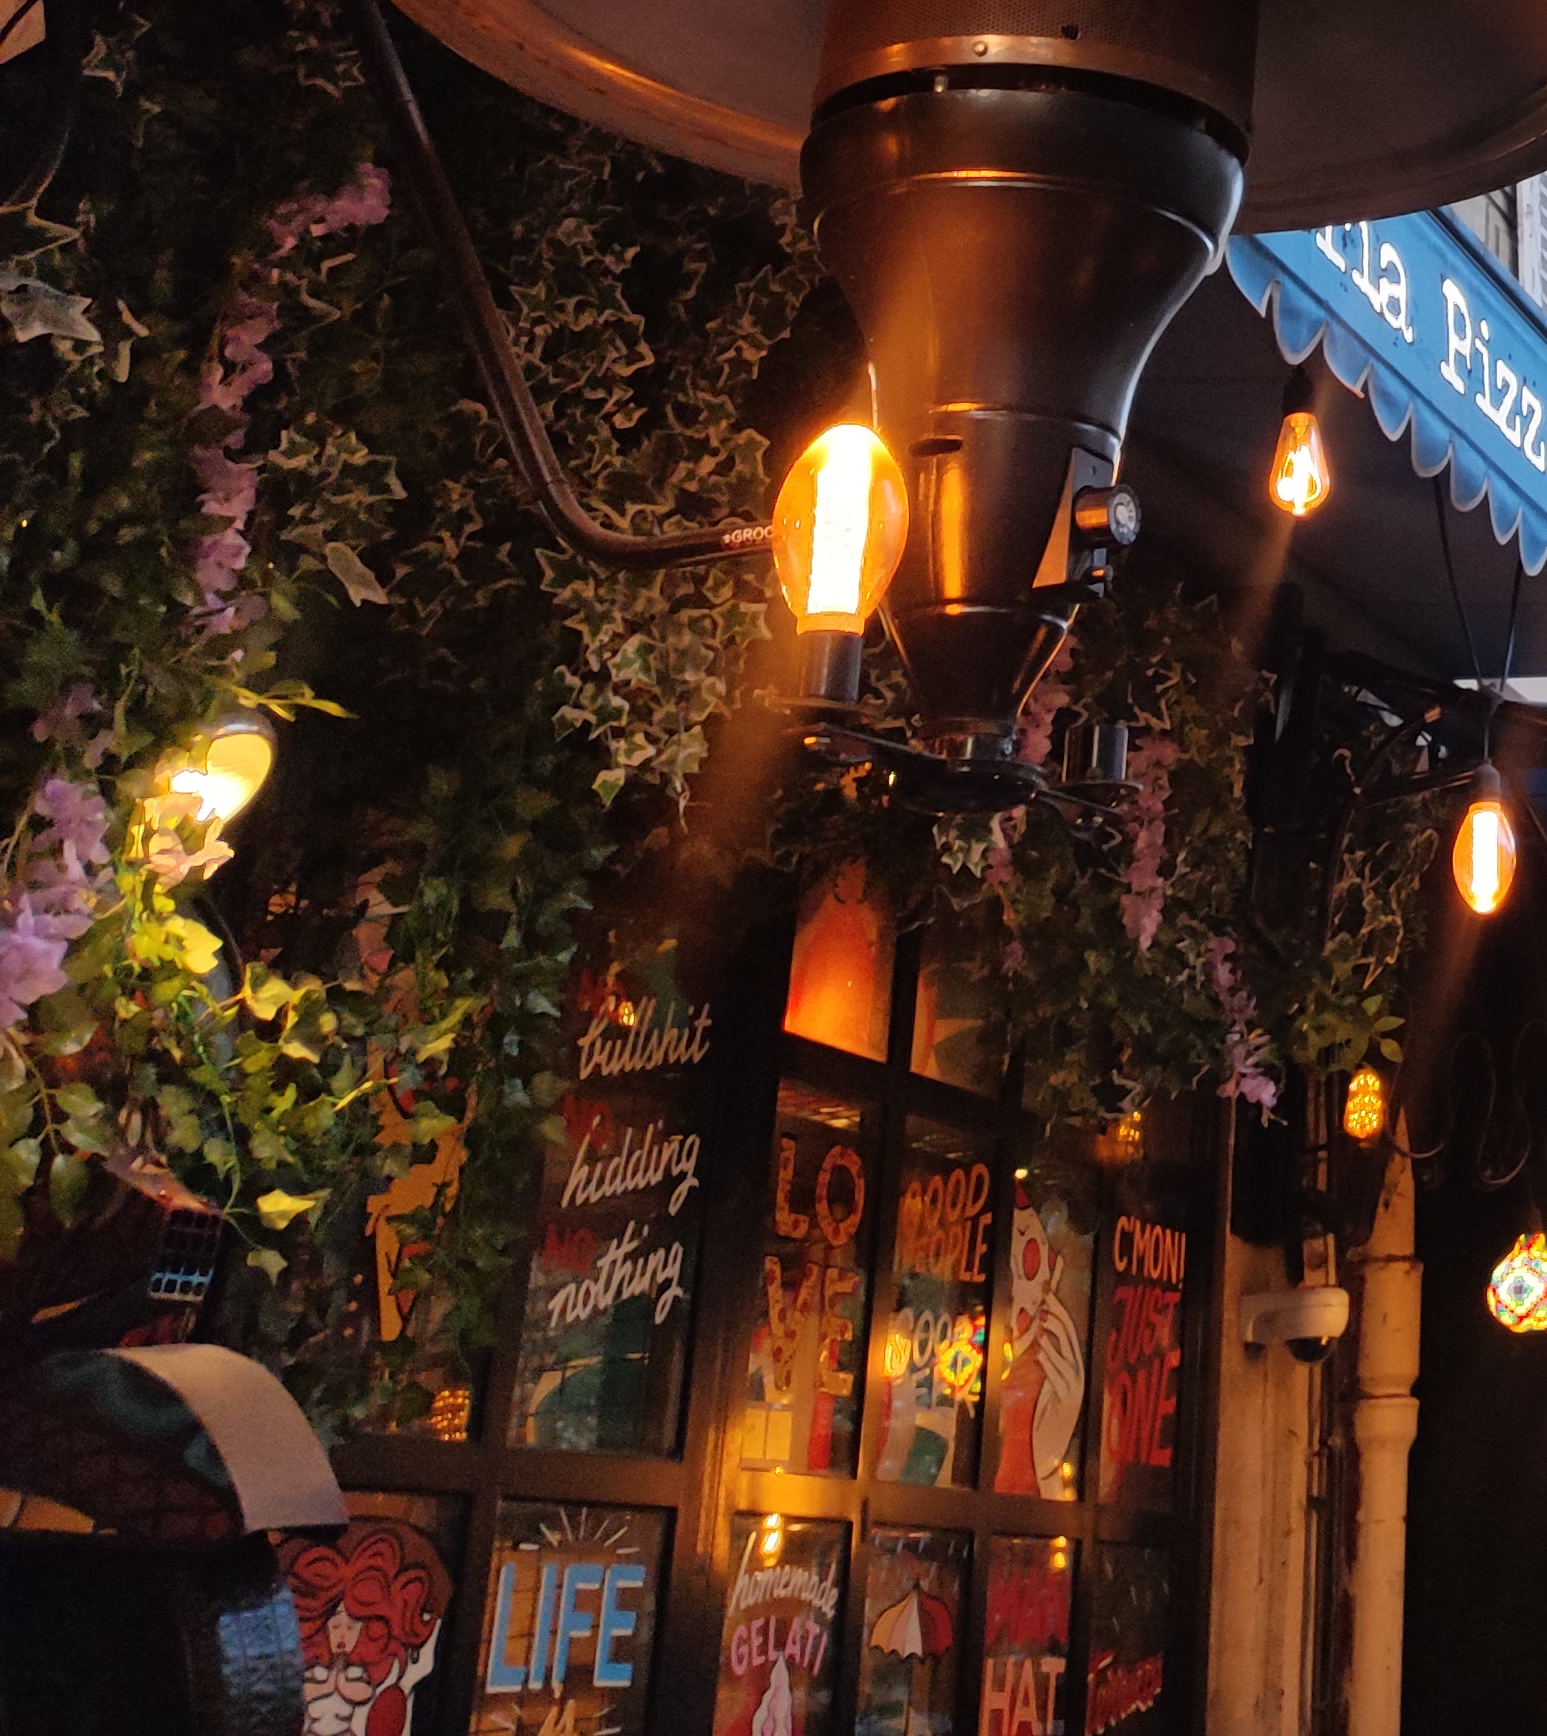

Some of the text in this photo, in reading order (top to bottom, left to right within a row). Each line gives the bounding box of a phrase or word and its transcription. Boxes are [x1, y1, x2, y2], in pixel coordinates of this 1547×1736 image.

[577, 995, 712, 1080] bullshit
[548, 1219, 684, 1326] nothing
[1113, 1215, 1186, 1289] C'MON!
[1106, 1284, 1182, 1372] JUST
[1108, 1349, 1182, 1468] ONE
[729, 1530, 840, 1619] homemade
[485, 1563, 647, 1698] LIFE
[730, 1614, 829, 1677] GELATI
[979, 1656, 1067, 1736] HAT
